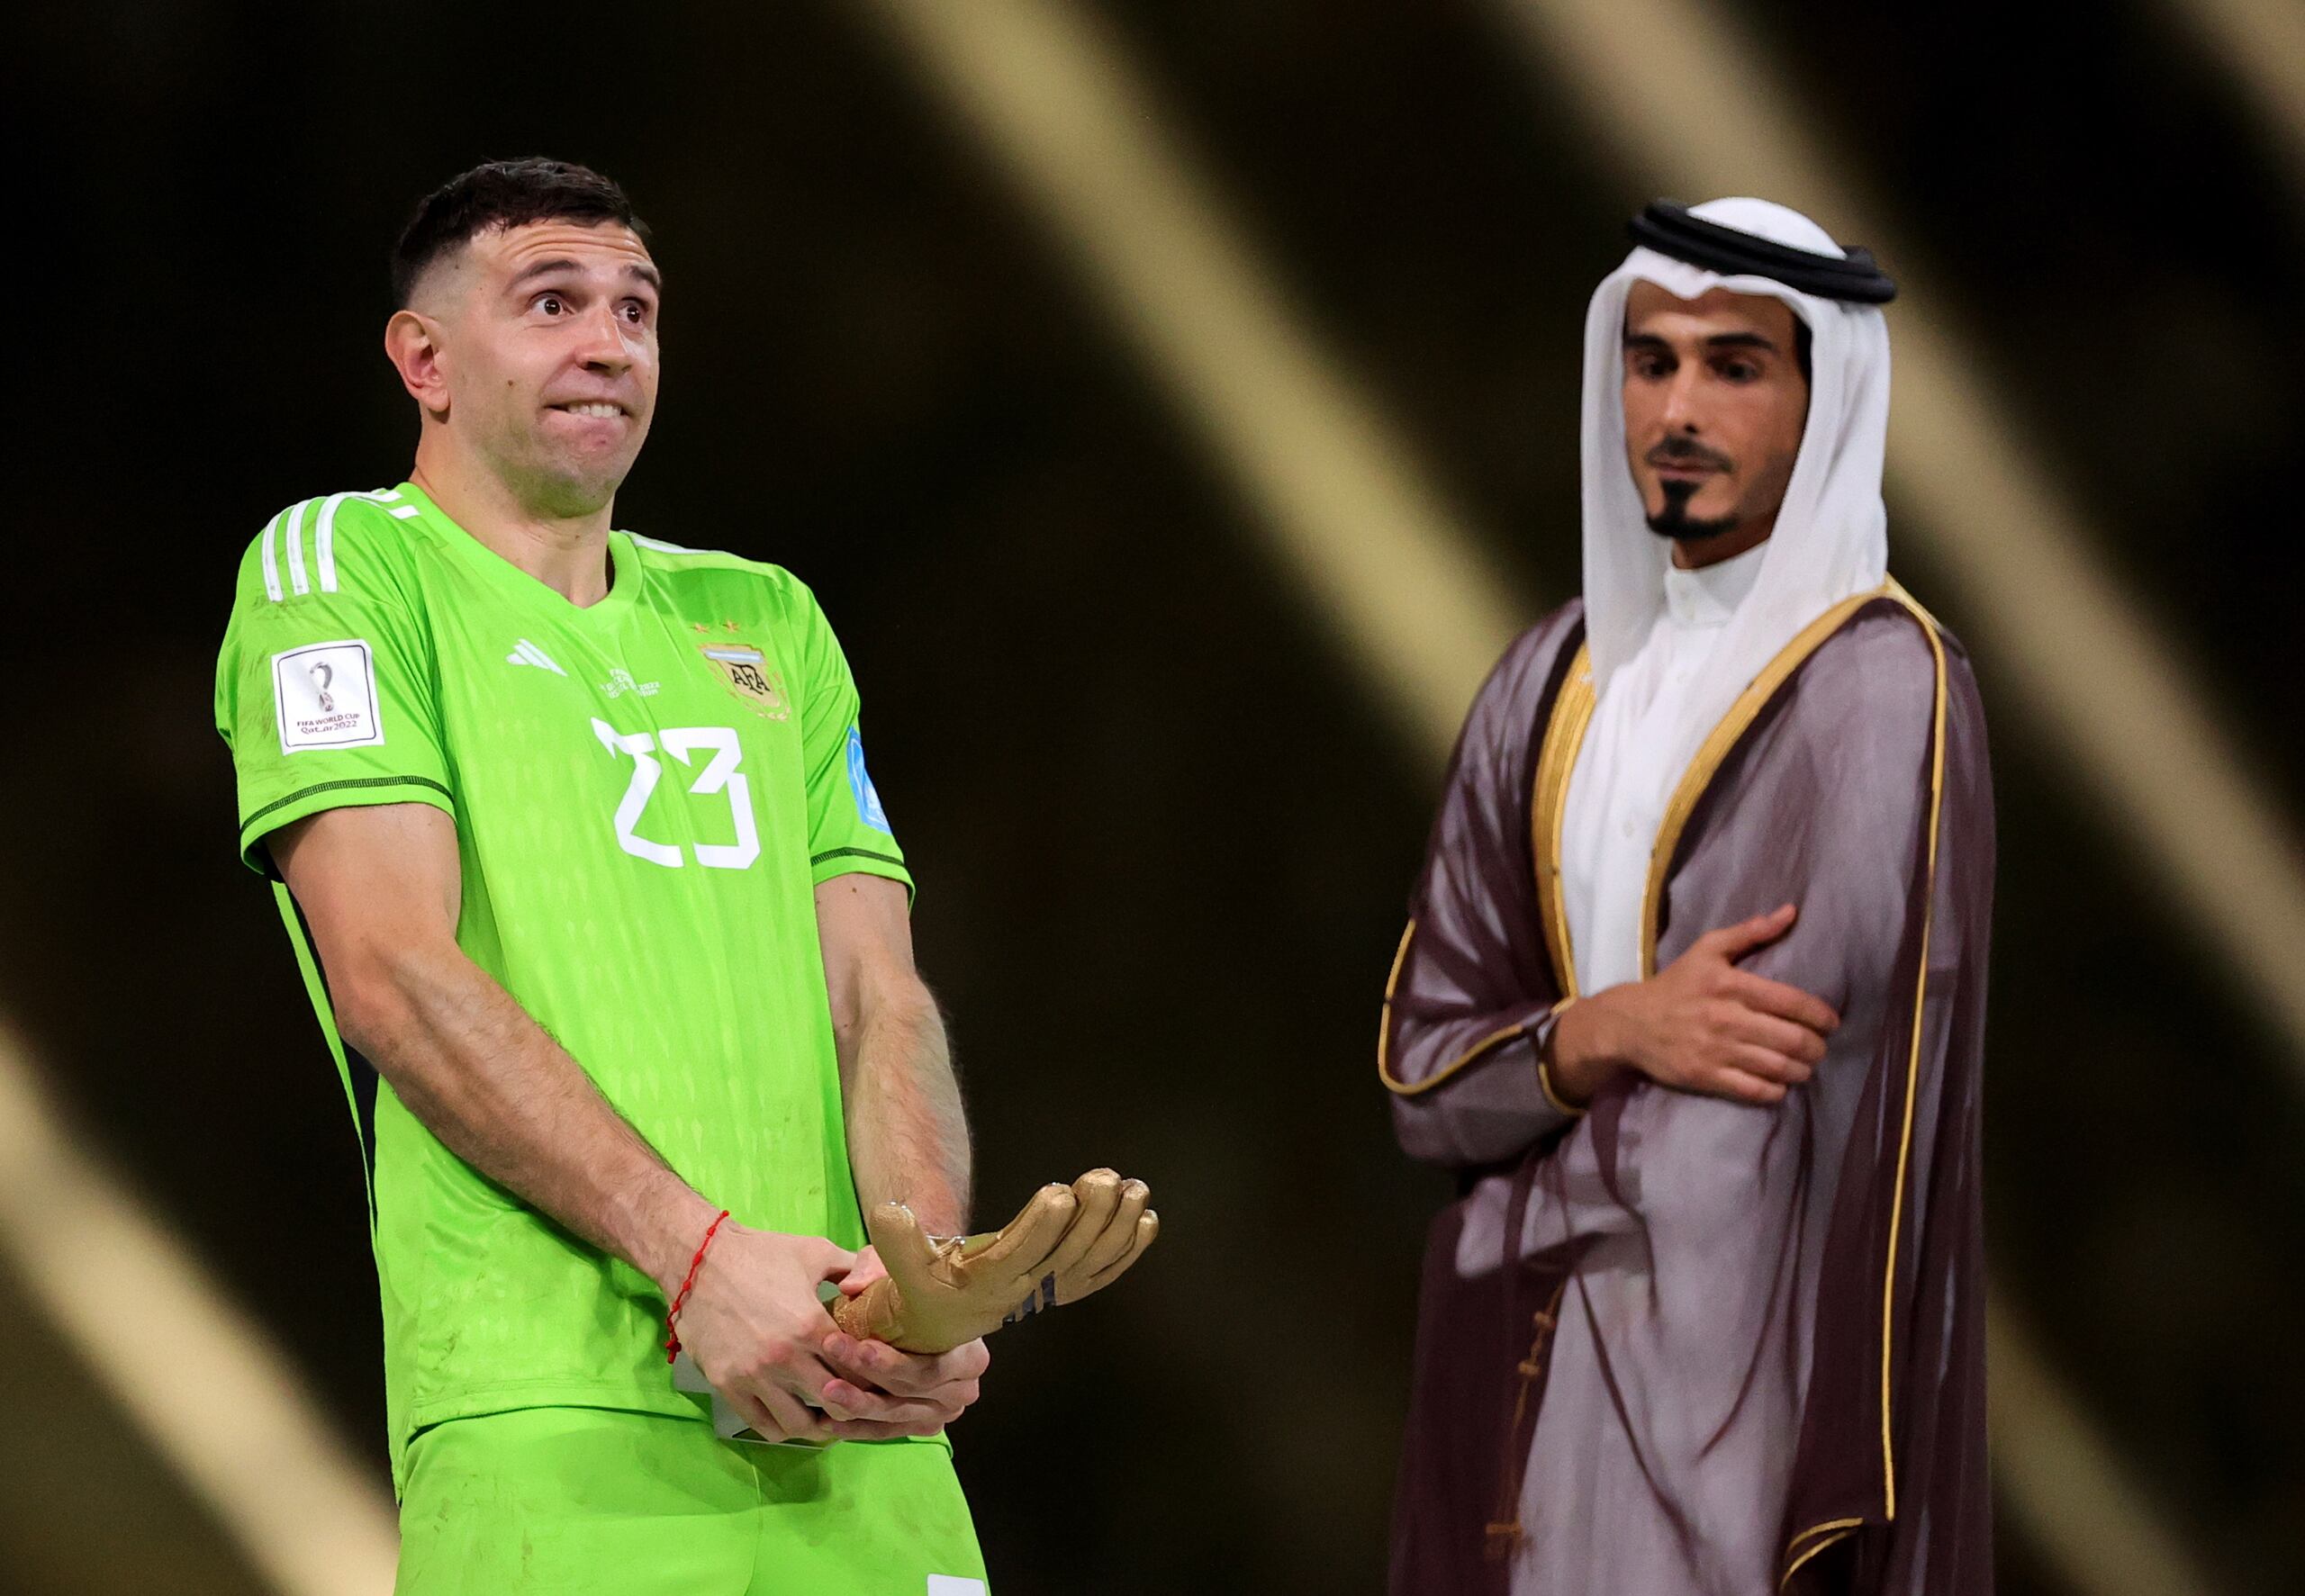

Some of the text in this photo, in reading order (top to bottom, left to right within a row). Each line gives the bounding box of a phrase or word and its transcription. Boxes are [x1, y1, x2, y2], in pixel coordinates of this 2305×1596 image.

[728, 663, 771, 696] AFA
[315, 715, 344, 725] WORLD
[590, 717, 762, 870] 23
